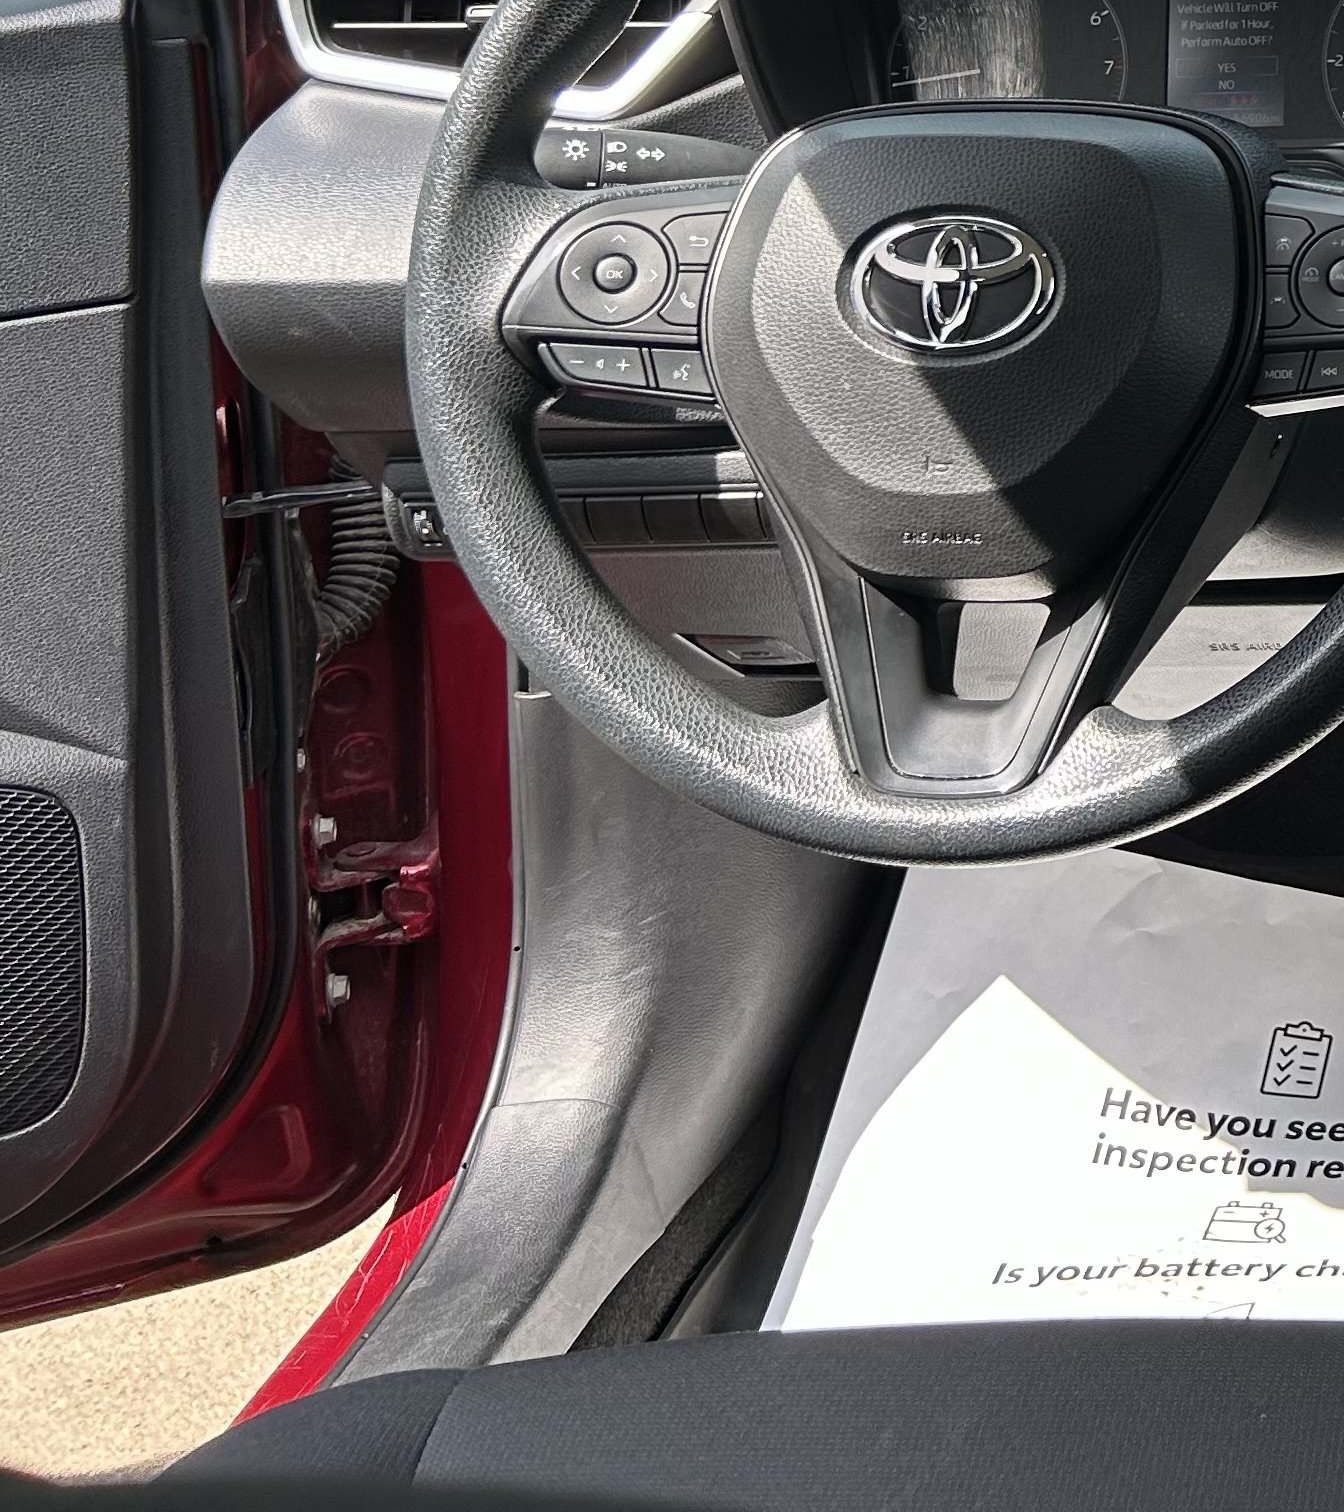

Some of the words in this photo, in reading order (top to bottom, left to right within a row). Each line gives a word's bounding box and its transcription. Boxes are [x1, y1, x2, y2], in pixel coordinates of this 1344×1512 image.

[1177, 3, 1213, 15] Vehicle
[1214, 2, 1234, 14] Will
[1236, 2, 1258, 13] Turn
[1259, 1, 1279, 12] OFF
[917, 16, 928, 31] 2
[1090, 11, 1102, 26] 6
[1190, 20, 1224, 31] Parked
[1225, 19, 1239, 30] for
[1181, 37, 1222, 48] Perform
[1223, 36, 1248, 47] Auto
[1249, 35, 1273, 46] OFF?
[1104, 60, 1115, 75] 7
[1217, 63, 1237, 73] YES
[1218, 80, 1235, 90] NO
[605, 269, 623, 279] OK
[1264, 369, 1295, 380] MODE
[1099, 1086, 1197, 1133] Have
[1203, 1108, 1277, 1144] you
[1091, 1132, 1298, 1180] inspection
[991, 1261, 1029, 1286] Is
[1030, 1263, 1127, 1286] your
[1132, 1256, 1286, 1285] battery
